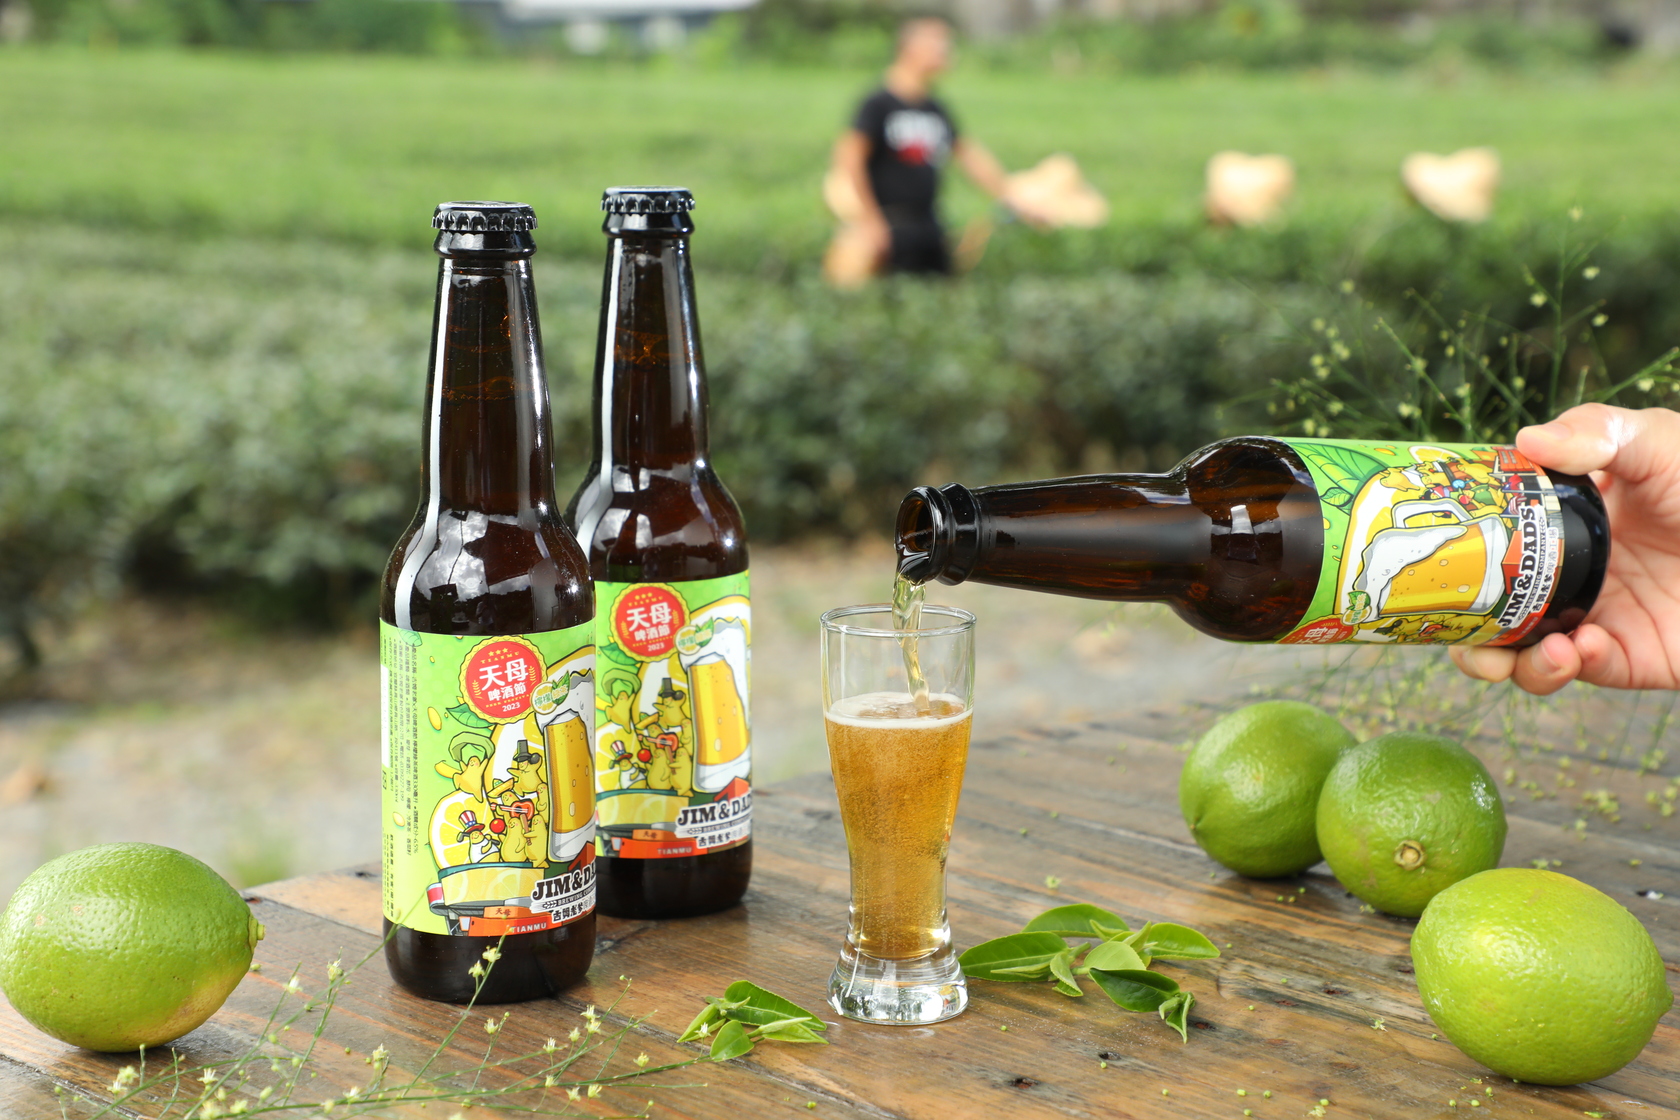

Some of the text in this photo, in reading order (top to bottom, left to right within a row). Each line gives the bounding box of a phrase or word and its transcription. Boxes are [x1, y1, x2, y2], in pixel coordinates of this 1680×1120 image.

[1538, 534, 1547, 573] COMPANY
[626, 602, 672, 632] 天母
[634, 624, 671, 642] 啤酒節
[479, 658, 529, 691] 天母
[488, 682, 527, 701] 啤酒節
[502, 702, 521, 712] 2023
[657, 847, 692, 855] TIANMU
[510, 922, 547, 933] TIANMU
